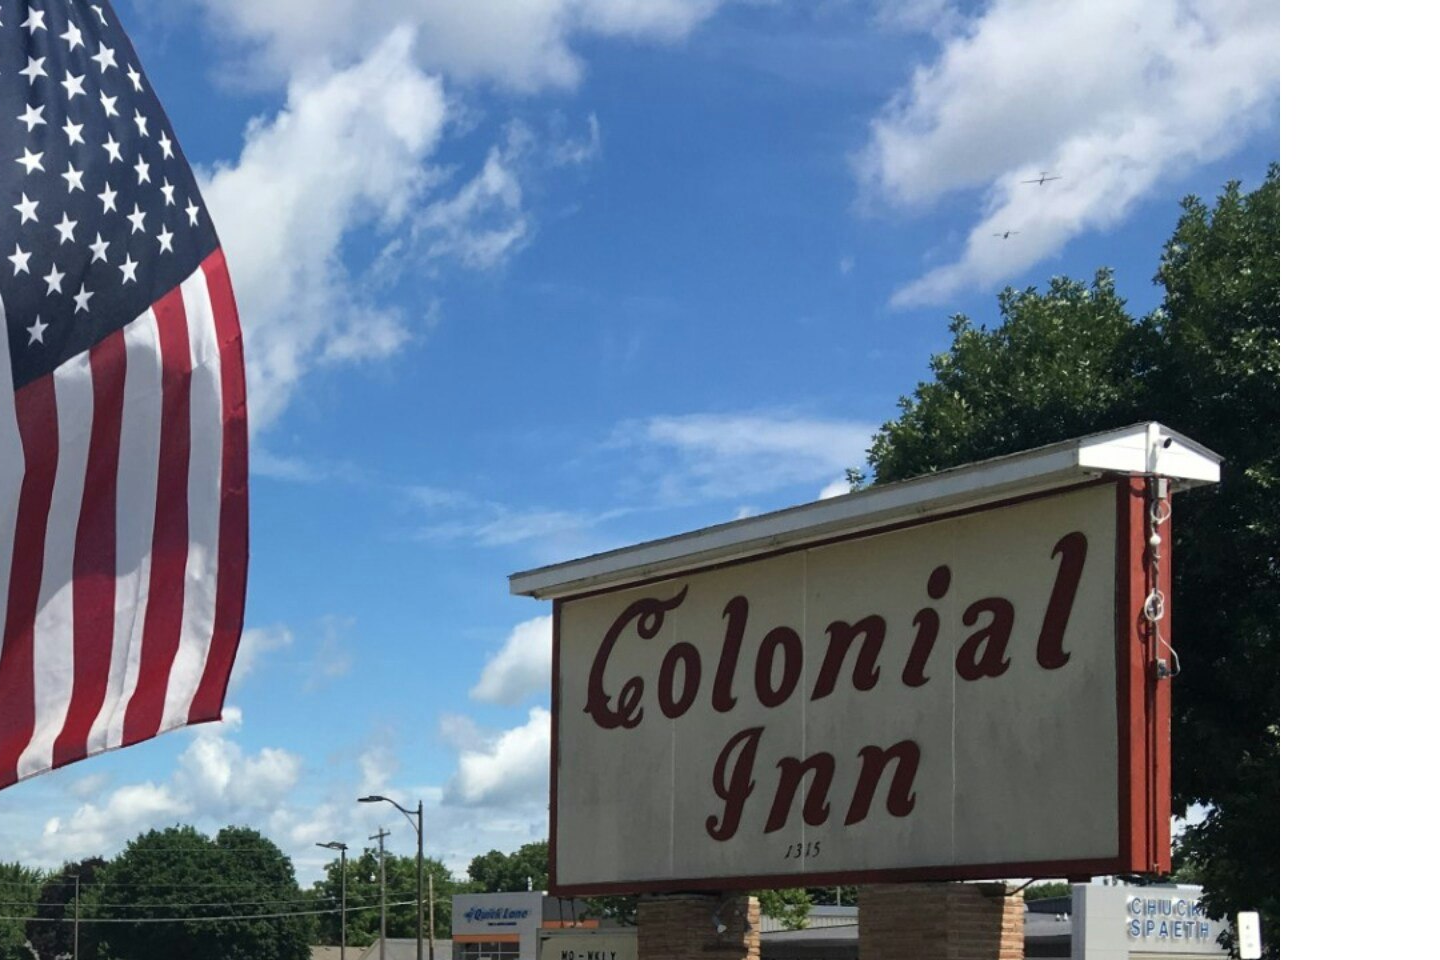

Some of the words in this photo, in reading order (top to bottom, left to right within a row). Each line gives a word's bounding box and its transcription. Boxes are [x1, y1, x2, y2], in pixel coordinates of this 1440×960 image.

[583, 531, 1088, 730] Colonial
[705, 726, 921, 842] Inn
[784, 841, 821, 859] 1315
[502, 907, 530, 919] Lane
[1131, 919, 1209, 938] SPAETH
